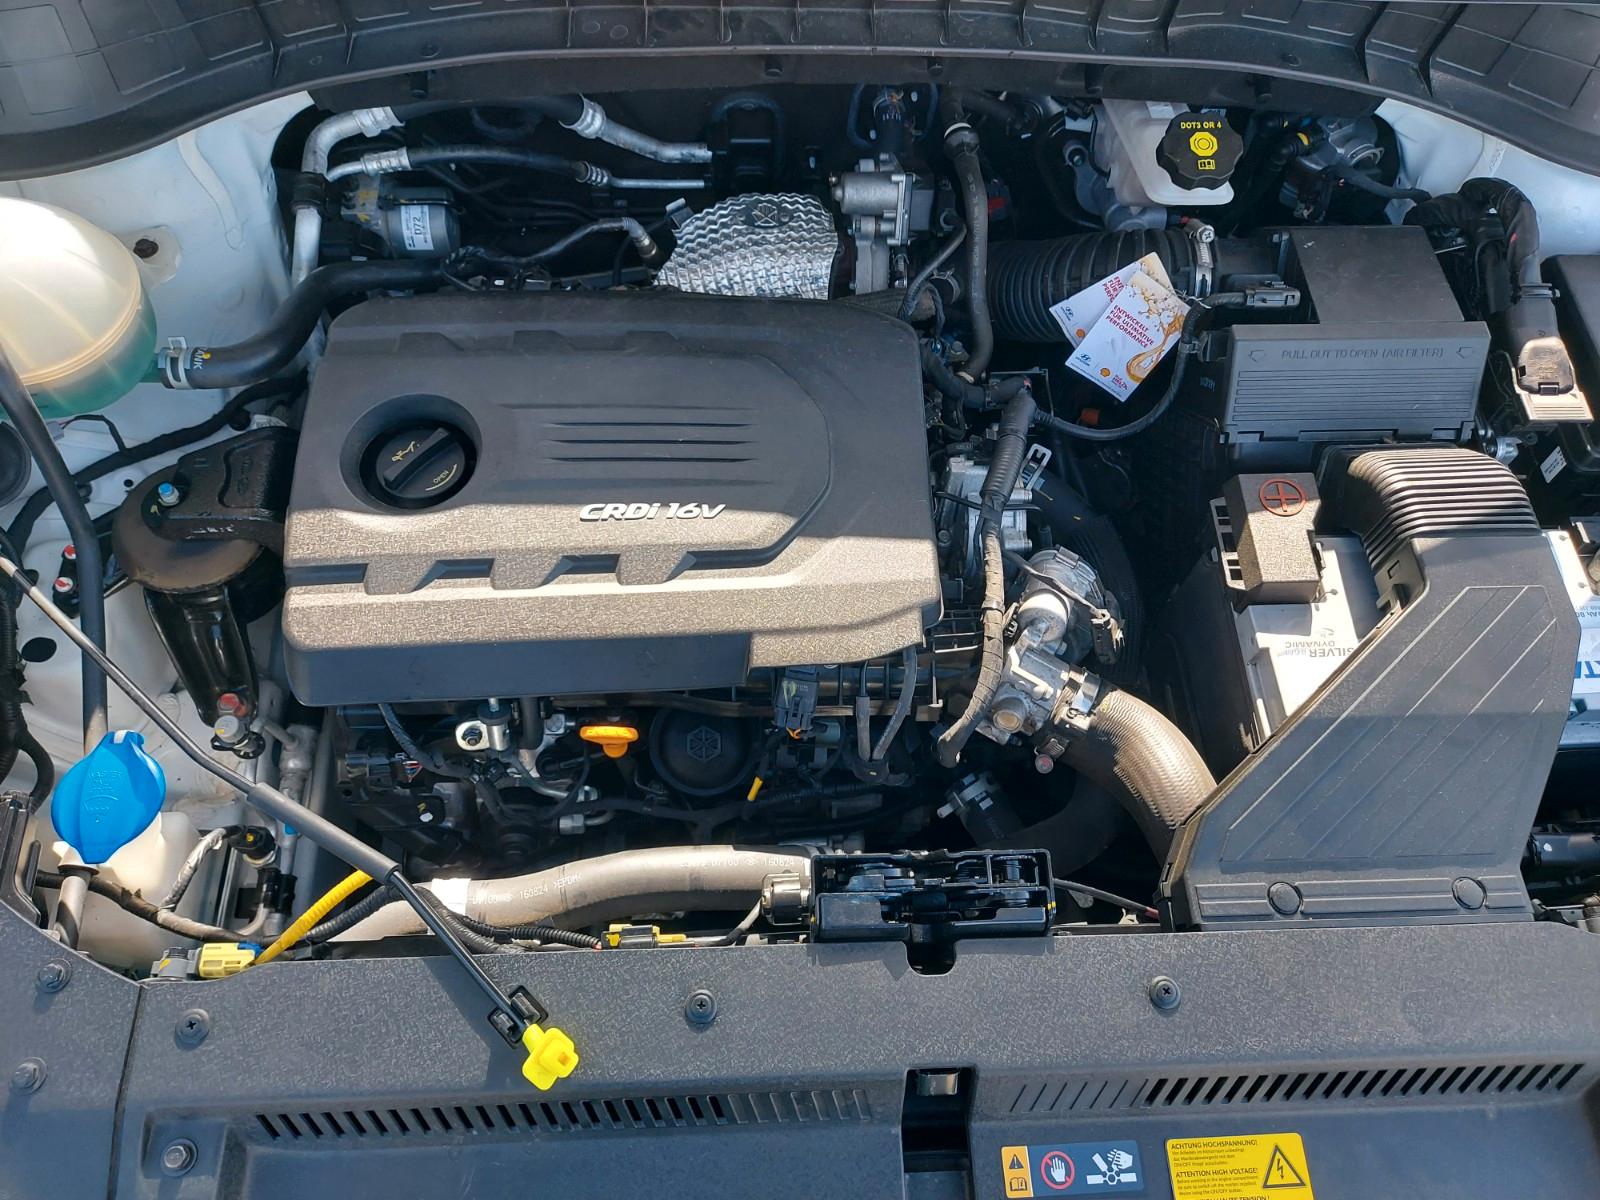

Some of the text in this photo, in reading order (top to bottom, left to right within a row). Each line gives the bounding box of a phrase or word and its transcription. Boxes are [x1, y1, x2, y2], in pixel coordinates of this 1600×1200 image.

[1181, 121, 1222, 129] DOT3 OR 4
[1113, 305, 1149, 333] ENTWICKELT
[1105, 315, 1148, 348] PERFORMANCE
[1110, 310, 1154, 345] FÜR ULTIMATIVE
[1281, 349, 1307, 360] PULL
[1310, 349, 1330, 359] OUT
[1335, 349, 1347, 359] TO
[1350, 349, 1379, 359] OPEN
[432, 470, 449, 484] OPEN
[580, 503, 661, 521] CRDi
[1309, 648, 1354, 657] SILVER
[519, 886, 549, 900] 160824
[1171, 1142, 1201, 1150] ACHTUNG
[1176, 1169, 1211, 1178] ATTENTION
